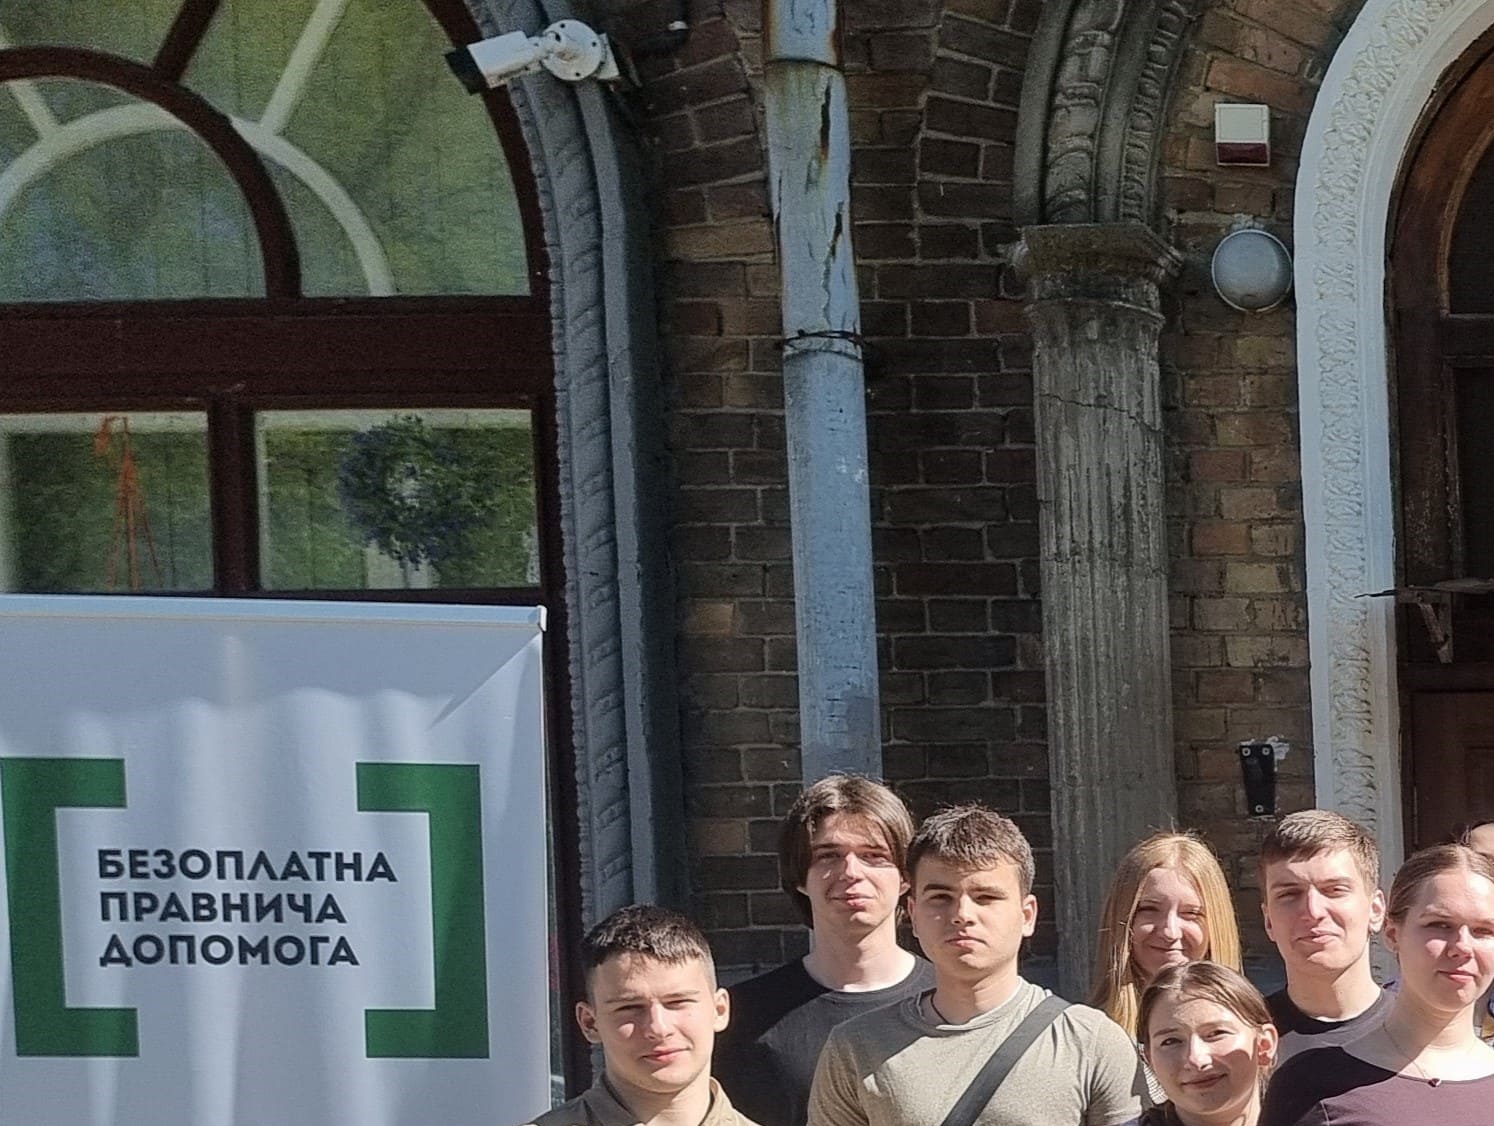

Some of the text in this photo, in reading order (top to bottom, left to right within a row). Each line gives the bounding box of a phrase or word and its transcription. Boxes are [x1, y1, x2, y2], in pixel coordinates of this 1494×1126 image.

[98, 848, 398, 882] БЕЗОПЛАТНА
[100, 892, 347, 924] ПРАВНИЧА
[99, 934, 360, 967] ДОПОМОГА
